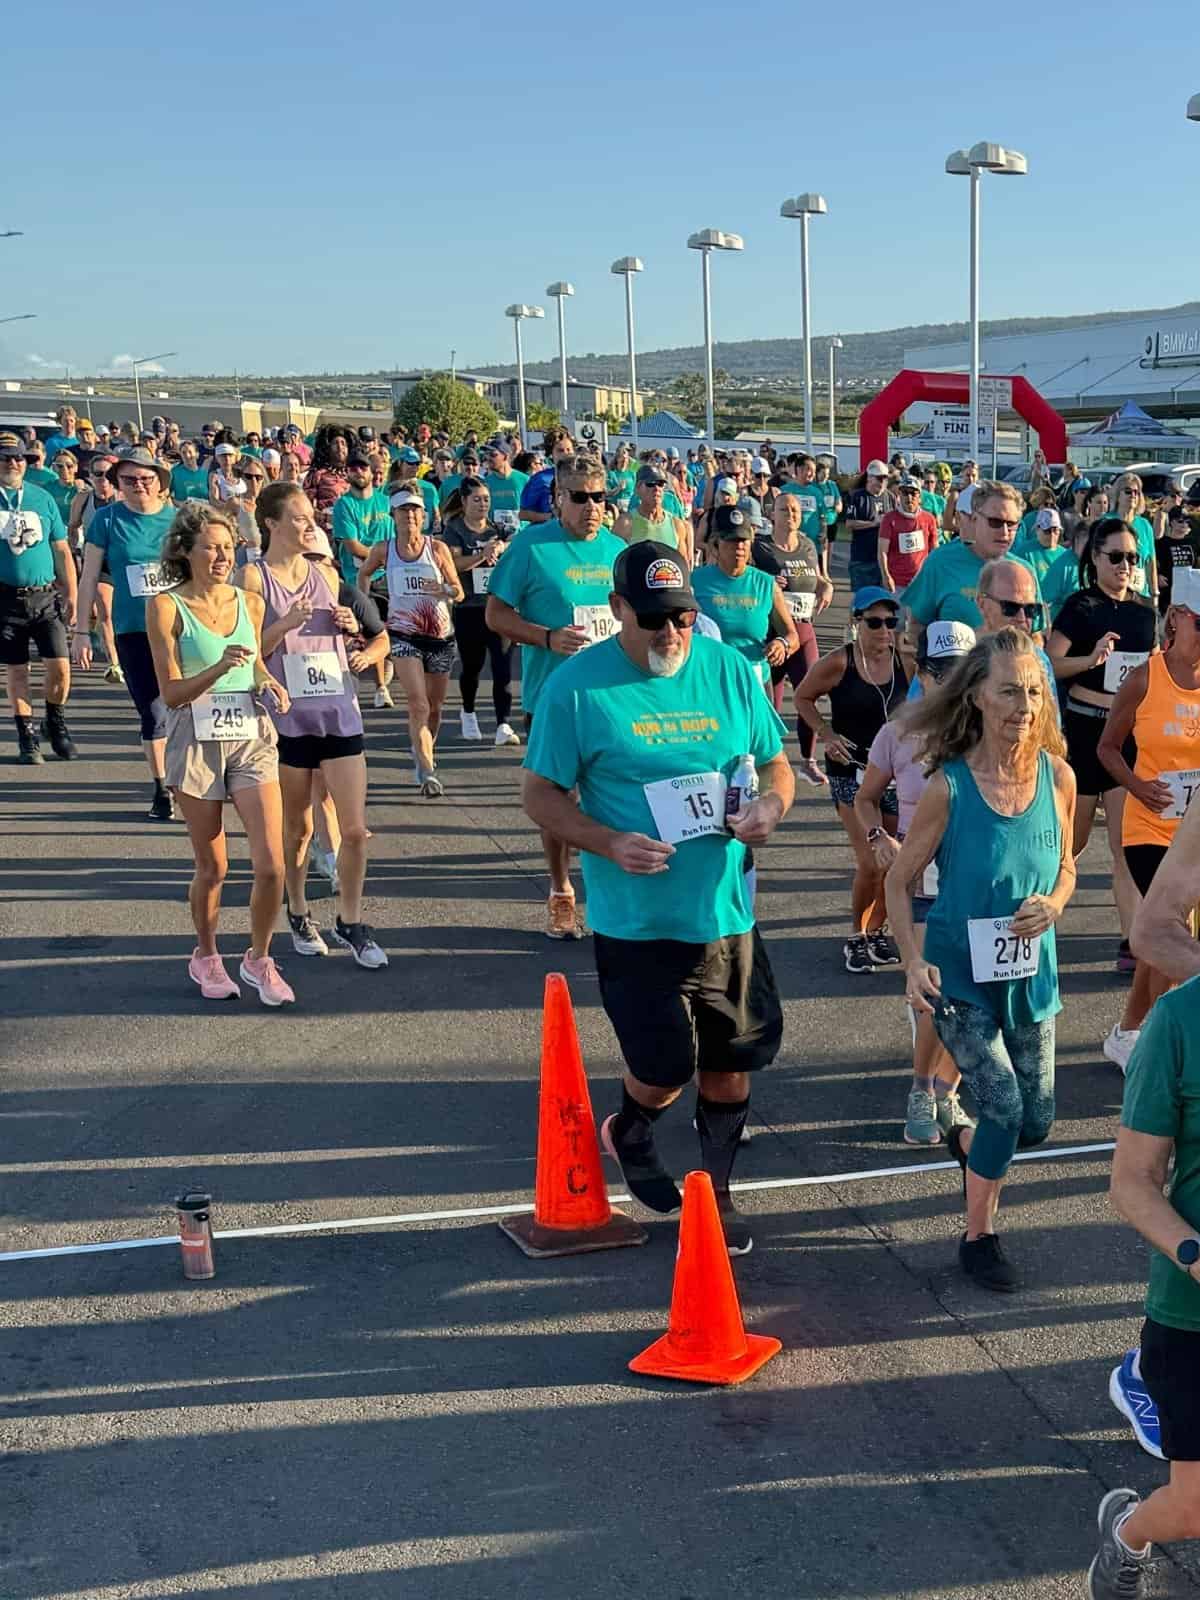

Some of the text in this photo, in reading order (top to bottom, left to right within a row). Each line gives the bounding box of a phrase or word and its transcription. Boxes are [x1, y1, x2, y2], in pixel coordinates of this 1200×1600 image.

[1163, 333, 1188, 353] BMW
[1188, 331, 1198, 352] of
[944, 423, 985, 434] FINIH
[307, 667, 326, 686] 84
[212, 708, 243, 728] 245
[685, 792, 714, 819] 15
[682, 828, 699, 838] Run
[994, 936, 1031, 964] 278
[993, 968, 1009, 978] Run
[1010, 968, 1023, 977] for
